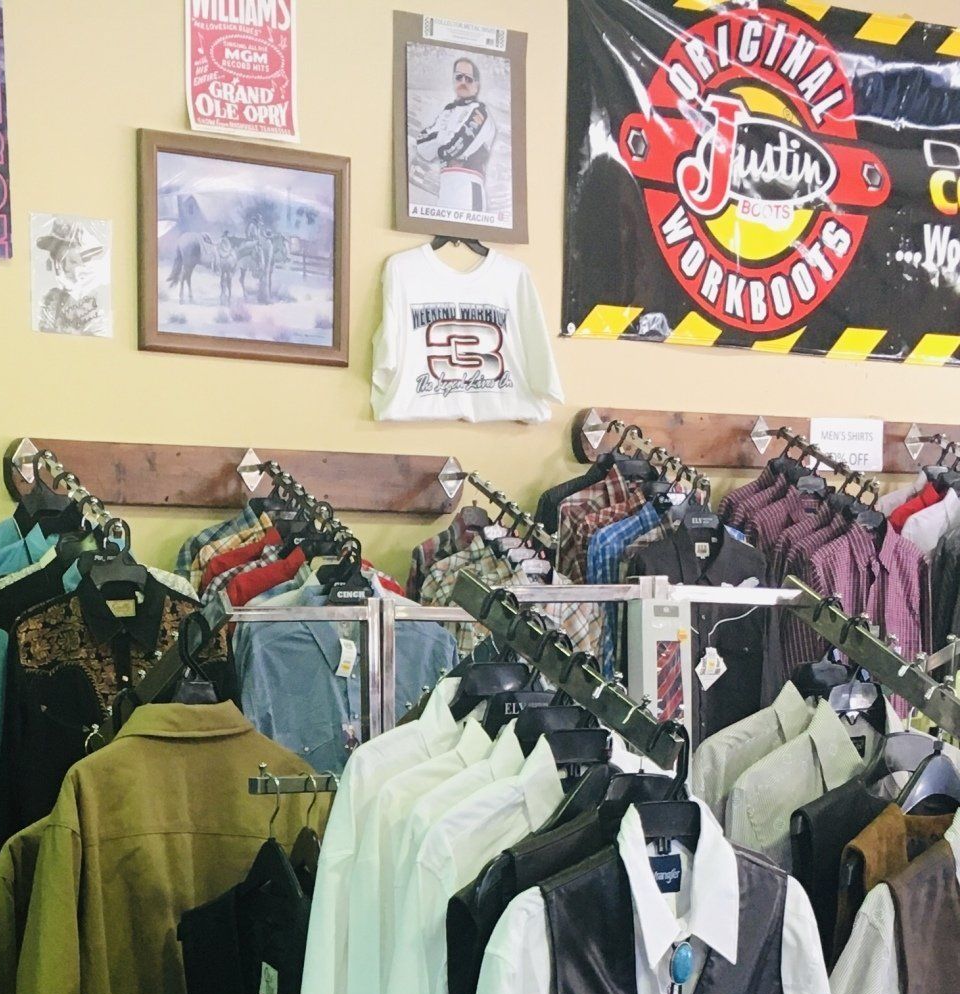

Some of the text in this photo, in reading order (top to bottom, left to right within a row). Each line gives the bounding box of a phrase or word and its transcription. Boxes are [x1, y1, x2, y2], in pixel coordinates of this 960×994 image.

[222, 59, 269, 73] RECORD HITS
[224, 48, 268, 64] MGM
[669, 20, 843, 125] ORIGINAL
[208, 80, 274, 104] GRAND
[195, 93, 289, 127] OLE OPRY
[677, 94, 823, 215] Justin
[412, 206, 495, 223] A LEGACY OF RACING
[741, 201, 790, 219] BOOTS
[662, 207, 851, 322] WORKBOOTS
[410, 302, 456, 331] WEEKEND
[425, 319, 505, 381] 3
[416, 374, 433, 393] The
[465, 370, 495, 391] Lives
[498, 371, 513, 389] On
[821, 430, 873, 441] MEN'S SHIRTS
[849, 452, 869, 466] OFF
[337, 590, 366, 599] CINCH
